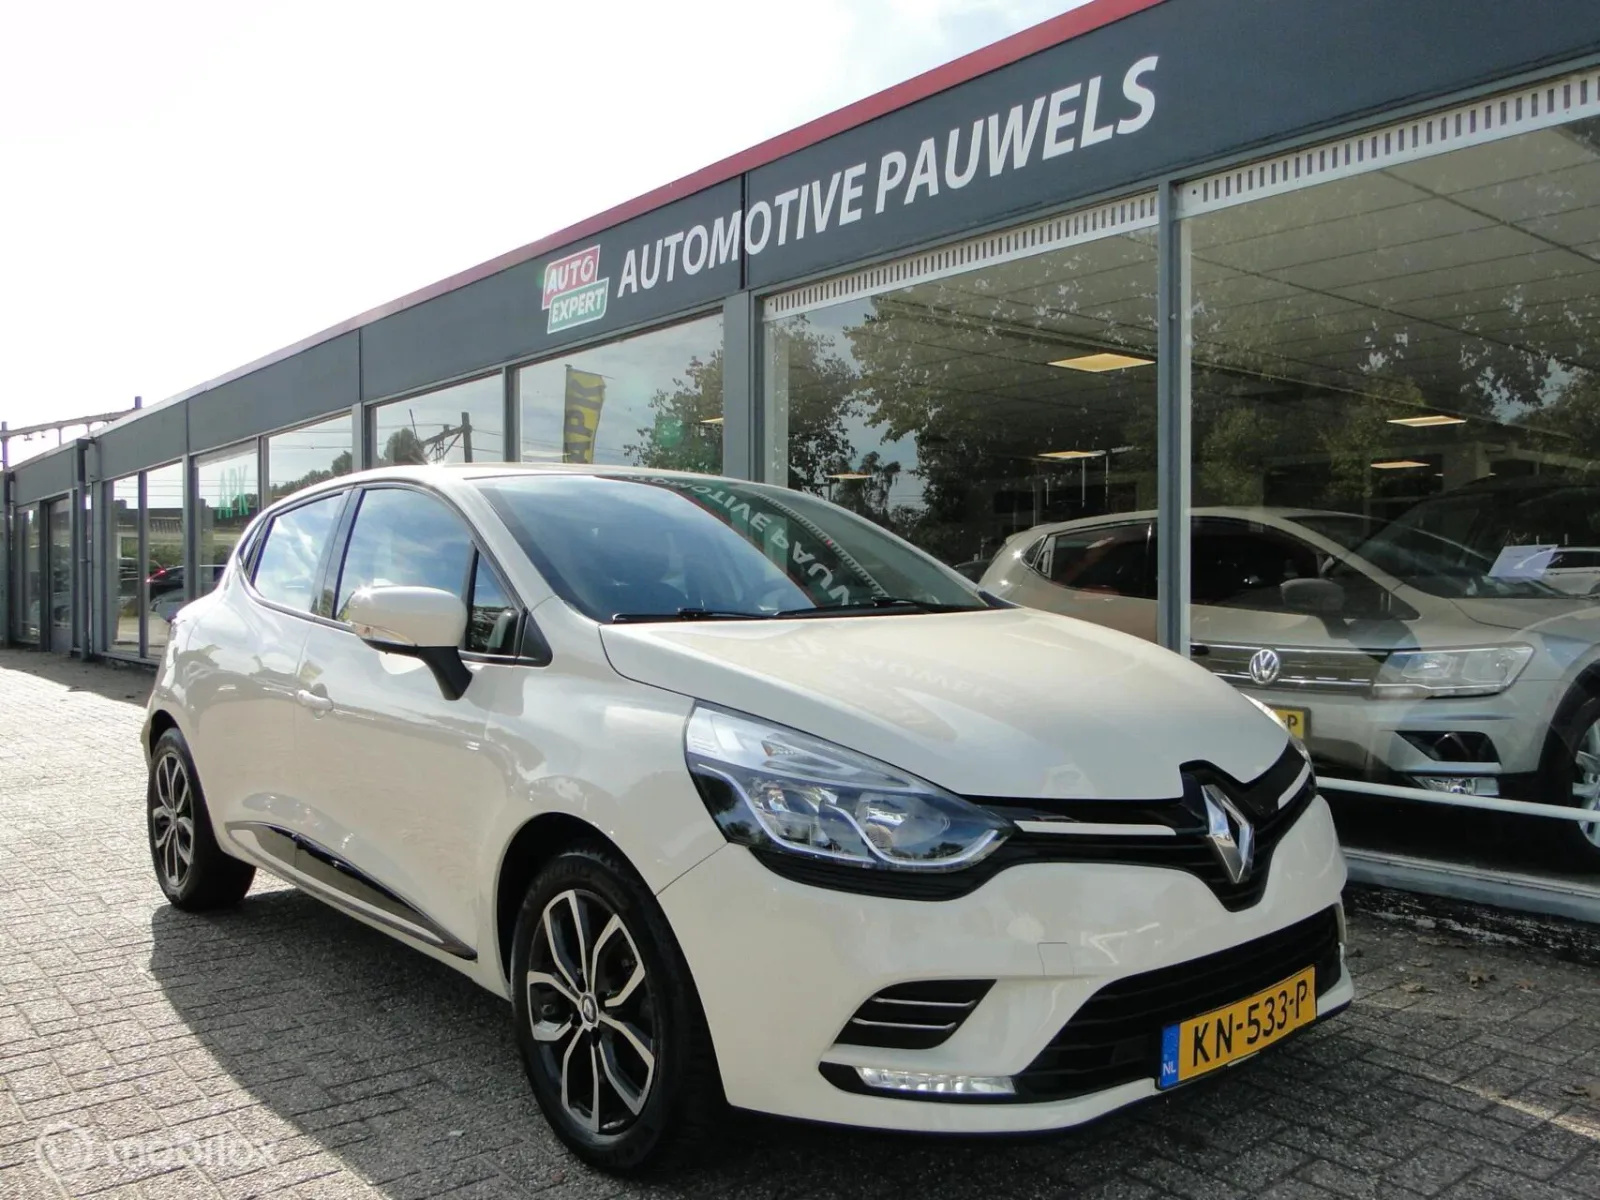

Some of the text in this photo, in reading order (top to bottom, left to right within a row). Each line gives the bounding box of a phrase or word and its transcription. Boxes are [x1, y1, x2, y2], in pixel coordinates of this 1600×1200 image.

[617, 56, 1159, 298] AUTOMOTIVE PAUWELS
[546, 255, 594, 294] AUTO
[552, 287, 605, 323] EXPERT
[1193, 979, 1308, 1067] KN-533-P
[1162, 1060, 1177, 1077] NL
